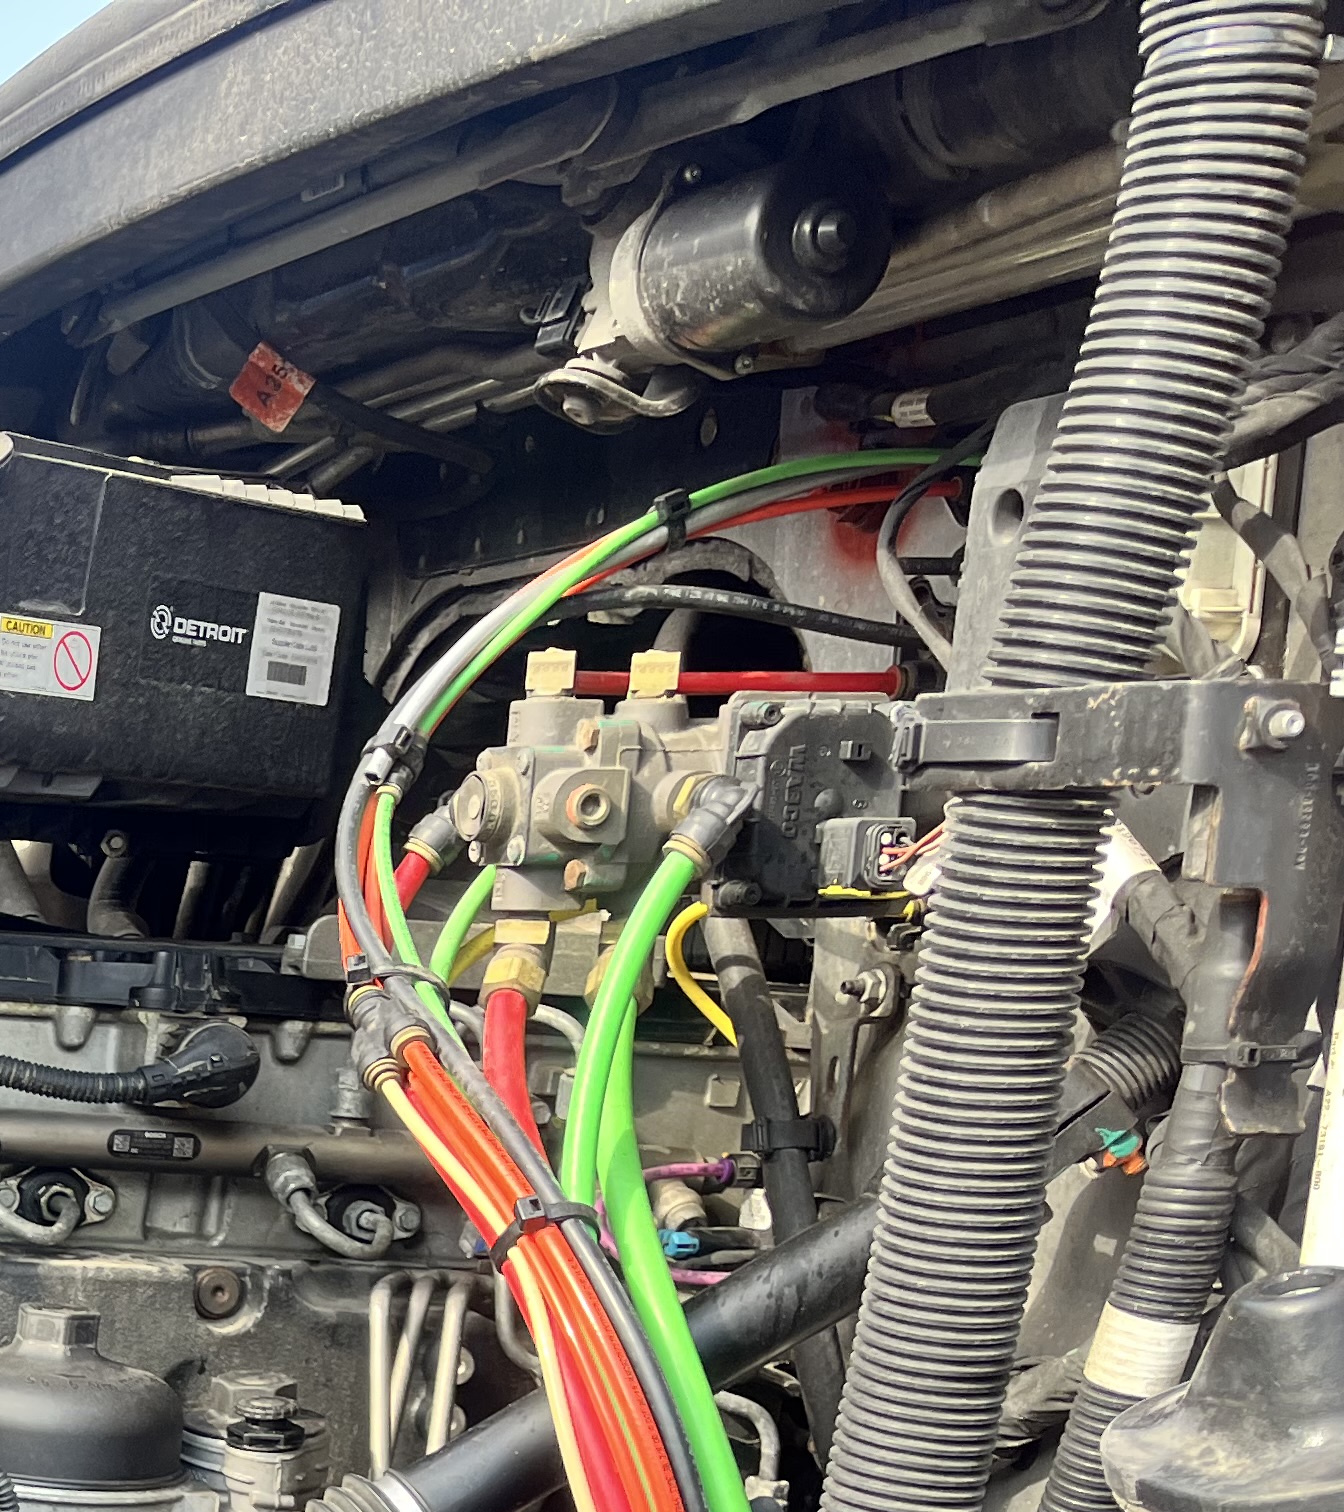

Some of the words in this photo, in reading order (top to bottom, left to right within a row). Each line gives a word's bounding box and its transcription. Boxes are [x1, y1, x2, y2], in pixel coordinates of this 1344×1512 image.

[6, 621, 46, 635] CAUTION
[173, 617, 248, 644] DETROIT
[782, 743, 806, 840] WABCO
